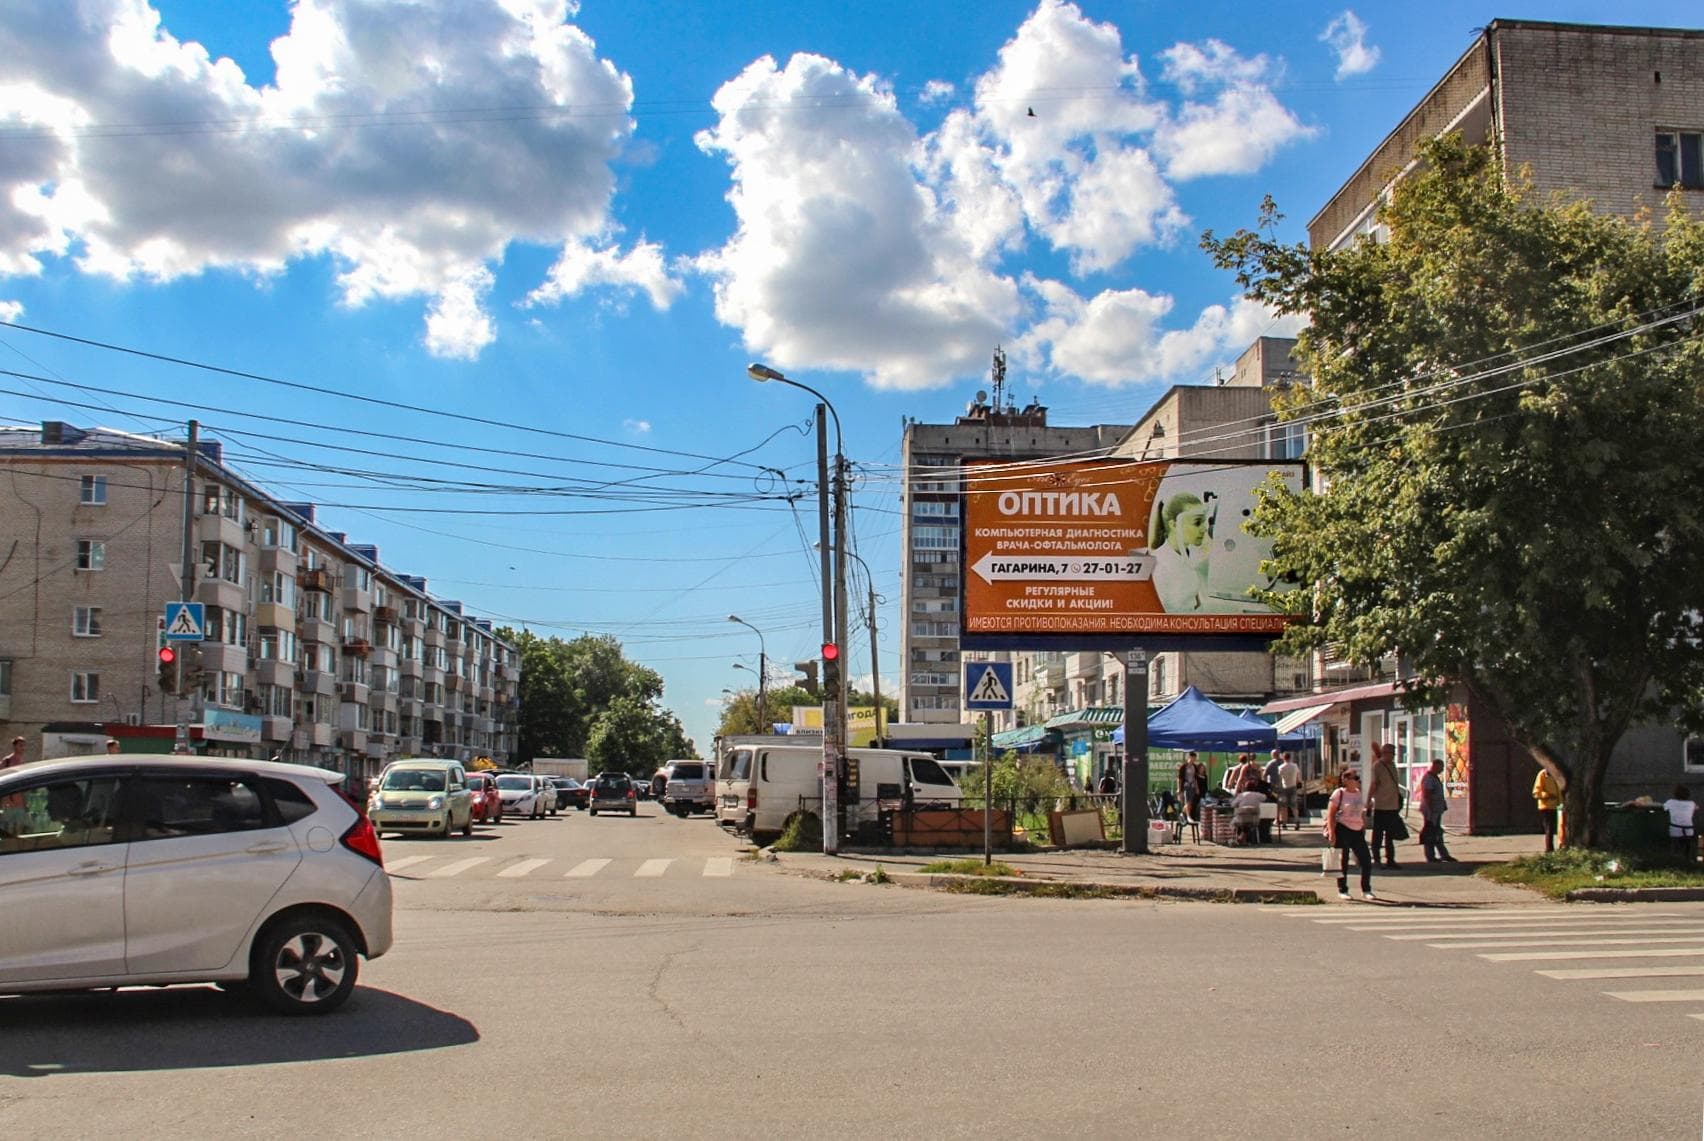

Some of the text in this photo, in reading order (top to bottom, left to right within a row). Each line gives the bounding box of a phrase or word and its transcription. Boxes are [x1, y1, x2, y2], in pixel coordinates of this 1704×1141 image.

[998, 492, 1121, 516] ОПТИКА
[975, 528, 1144, 539] КОМПЬЮТЕРНАЯ ДИАГНОСТИКА
[996, 541, 1122, 550] ВРАЧА-ОФТАЛЬМОЛОГА
[1083, 563, 1142, 574] 27-01-27
[1025, 587, 1095, 596] РЕГУЛЯРНЫЕ
[1006, 599, 1113, 609] СКИДКИ И АКЦИИ!
[969, 616, 1011, 629] ИМЕЮТСЯ
[1109, 616, 1169, 630] НЕОБХОДИМА
[1170, 617, 1237, 630] КОНСУЛЬТАЦИЯ
